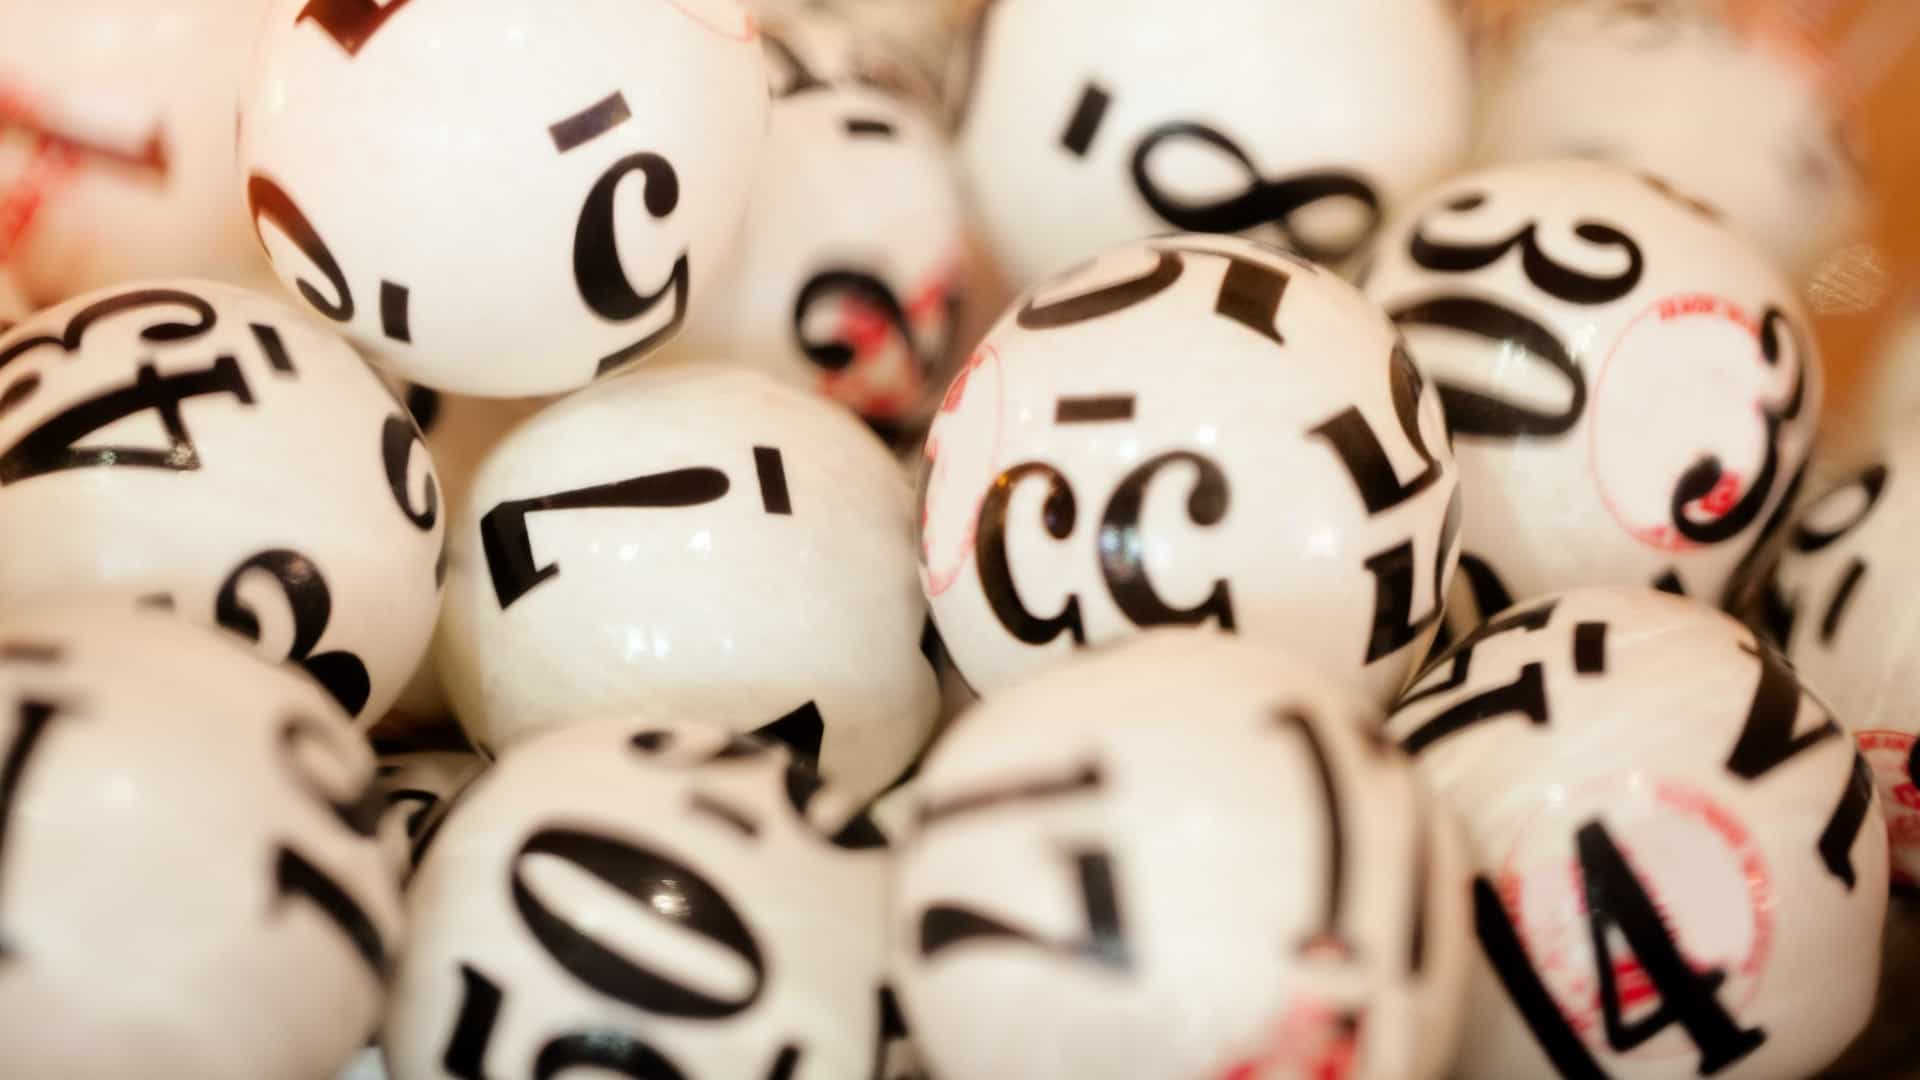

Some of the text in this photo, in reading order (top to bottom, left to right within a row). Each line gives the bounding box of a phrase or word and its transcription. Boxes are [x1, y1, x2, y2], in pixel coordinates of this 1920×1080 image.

[1129, 120, 1382, 263] 8
[975, 450, 1240, 648] 55
[1472, 818, 1770, 1080] 14
